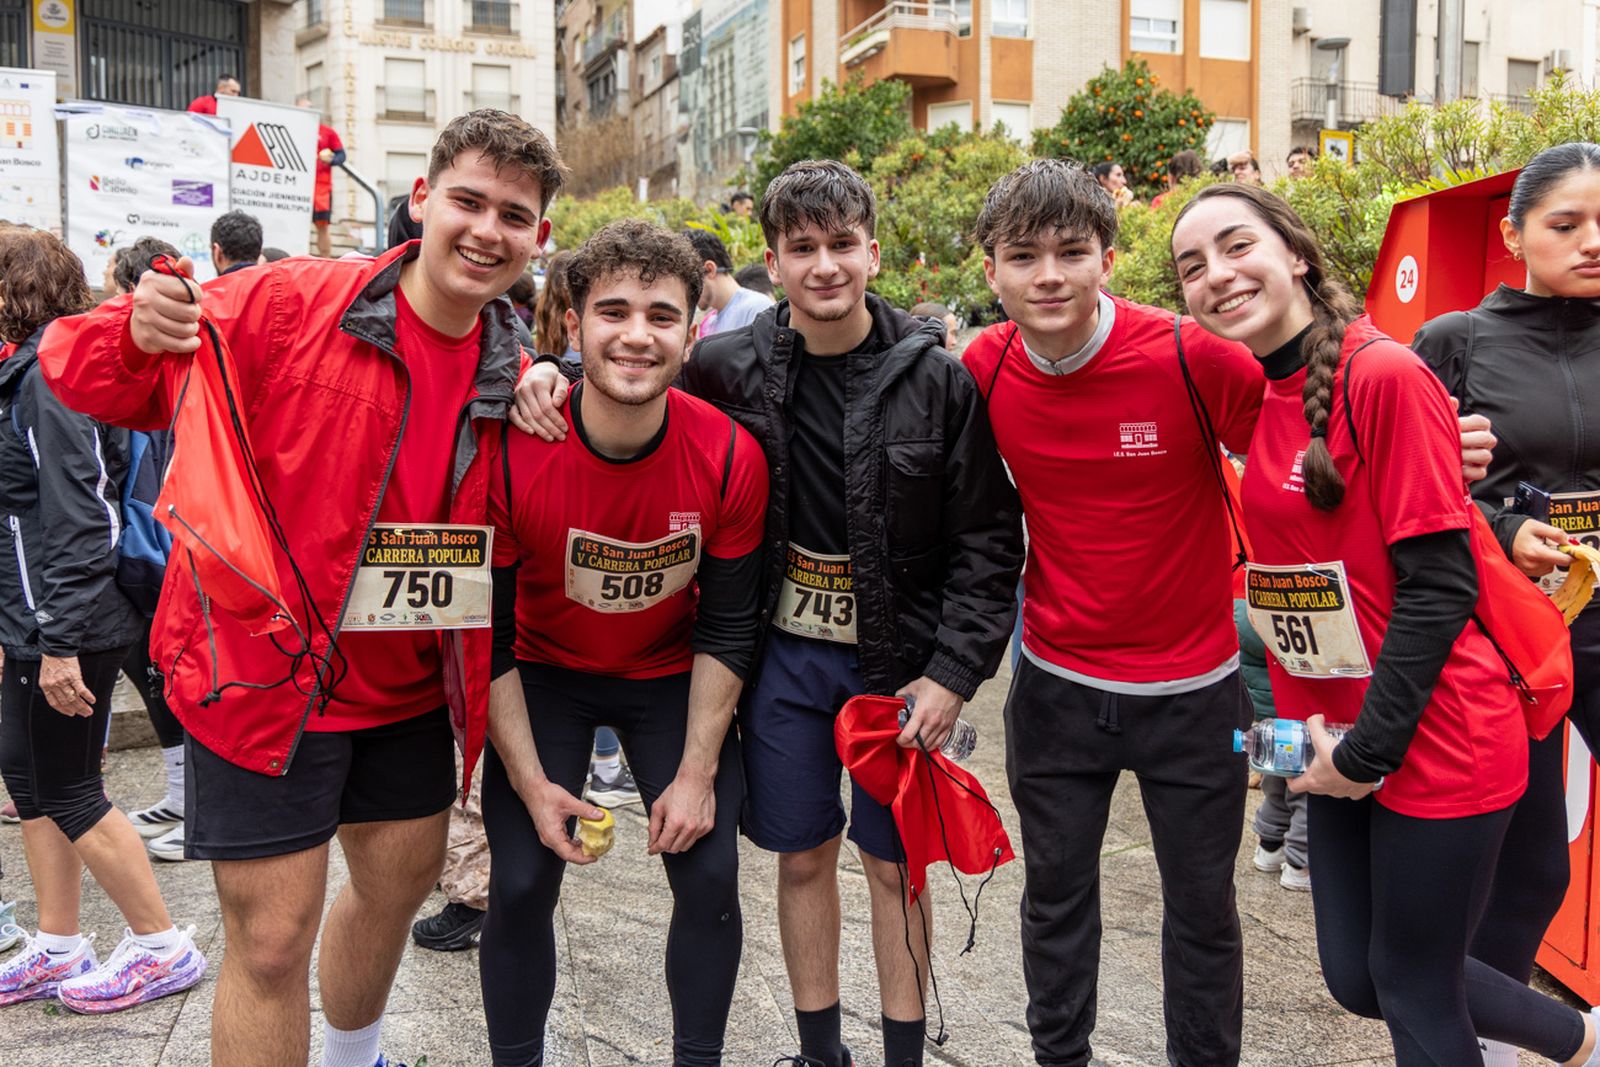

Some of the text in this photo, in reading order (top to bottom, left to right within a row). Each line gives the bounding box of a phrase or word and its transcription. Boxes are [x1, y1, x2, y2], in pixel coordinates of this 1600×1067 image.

[418, 35, 476, 54] COLEGIO
[484, 41, 537, 59] OFICIAL
[236, 169, 297, 186] AJDEM
[231, 187, 266, 198] CIACIÓN
[232, 198, 273, 208] SCLEROSIS
[1400, 269, 1414, 289] 24
[1577, 500, 1600, 513] Jua
[1551, 516, 1594, 531] RRERA
[381, 531, 405, 545] San
[409, 531, 438, 545] Juan
[442, 532, 478, 545] Bosco
[366, 548, 480, 563] CARRERA POPULAR
[602, 546, 624, 559] San
[628, 548, 655, 560] Juan
[658, 537, 688, 556] Bosco
[577, 548, 691, 571] V CARRERA POPULAR
[796, 555, 815, 571] San
[818, 561, 844, 574] Juan
[787, 564, 829, 589] CARRERA
[1258, 573, 1271, 588] San
[1272, 575, 1294, 589] Juan
[1294, 574, 1328, 589] Bosco
[382, 570, 453, 608] 750
[600, 572, 664, 601] 508
[792, 586, 854, 627] 743
[1255, 590, 1288, 608] CARRERA
[1288, 591, 1339, 608] POPULAR
[1271, 614, 1319, 656] 561
